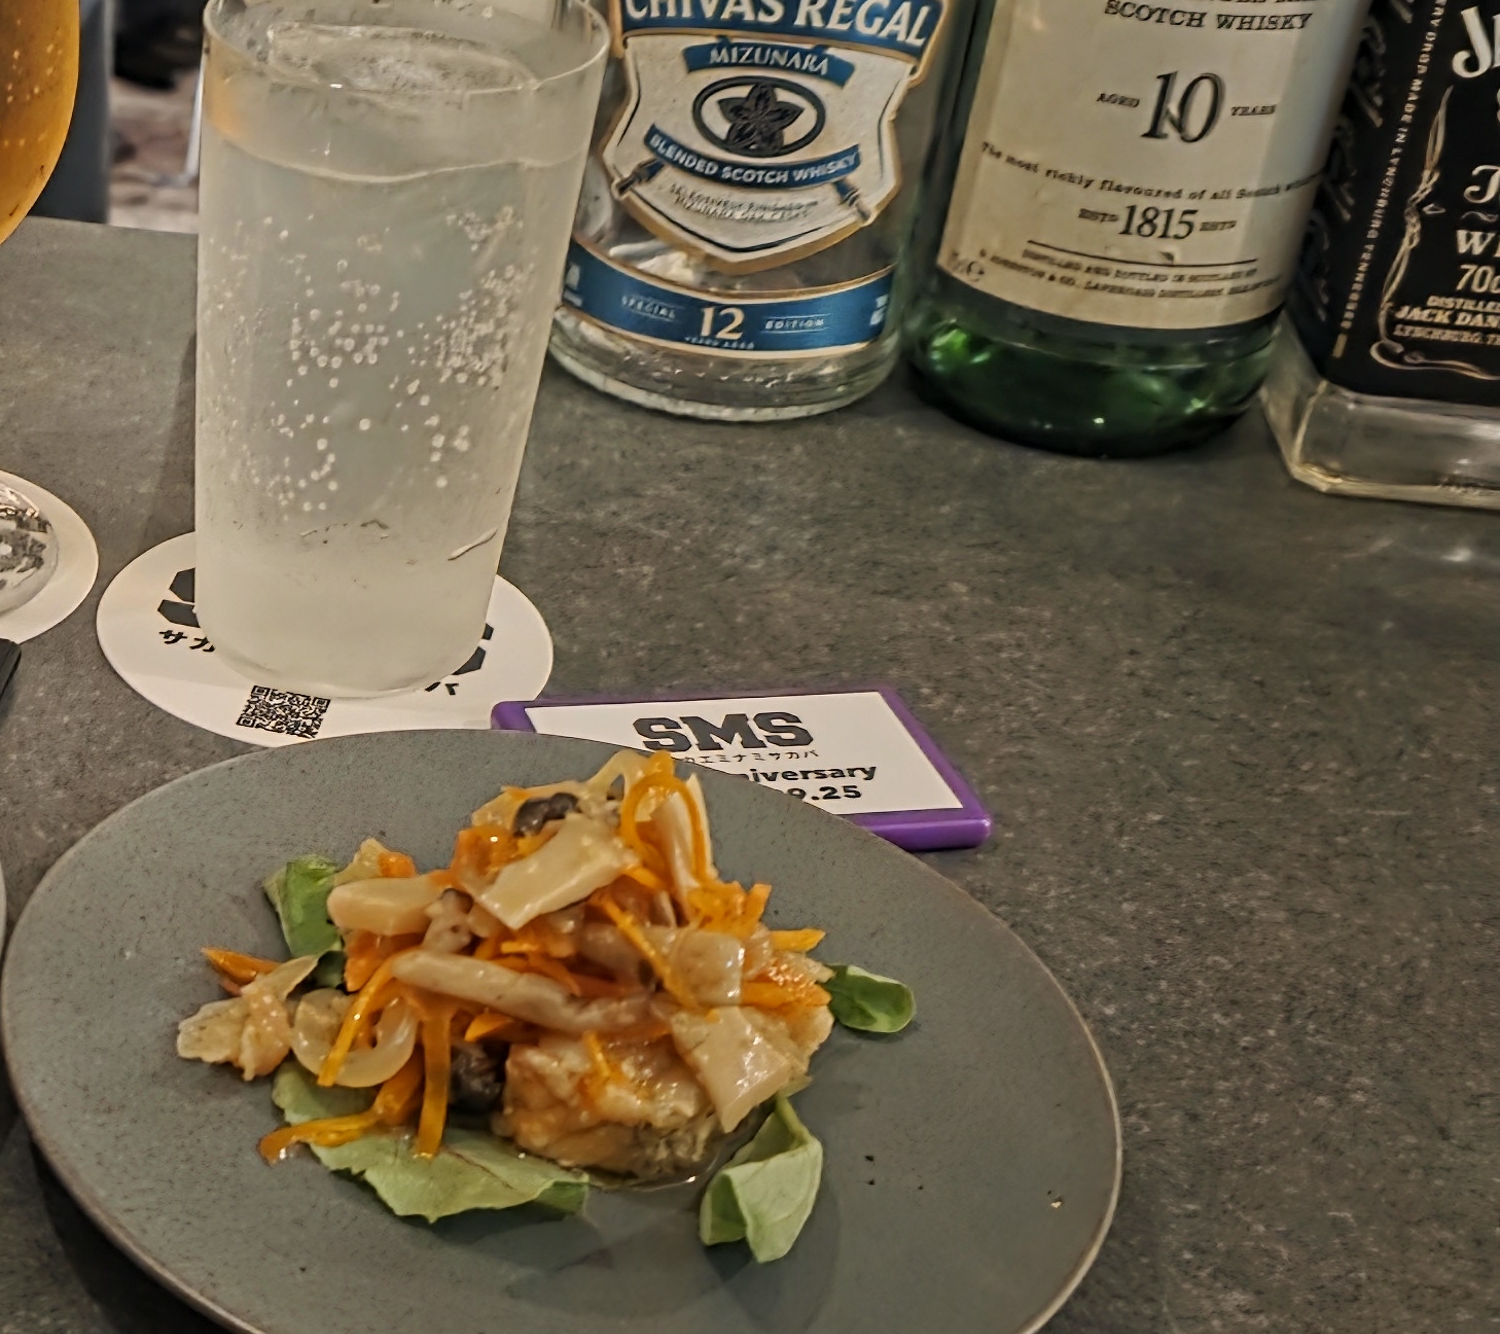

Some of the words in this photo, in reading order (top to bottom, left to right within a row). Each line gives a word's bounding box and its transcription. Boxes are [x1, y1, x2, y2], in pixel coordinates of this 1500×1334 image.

[1215, 12, 1313, 31] WHISKY
[709, 45, 828, 76] MIZUNARA
[1140, 70, 1226, 144] 10
[650, 133, 720, 175] BLENDED
[721, 166, 789, 184] SCOTCH
[792, 151, 859, 182] WHISKY
[1118, 204, 1199, 240] 1815
[700, 306, 745, 340] 12
[632, 711, 814, 753] SMS
[747, 766, 877, 784] iversary
